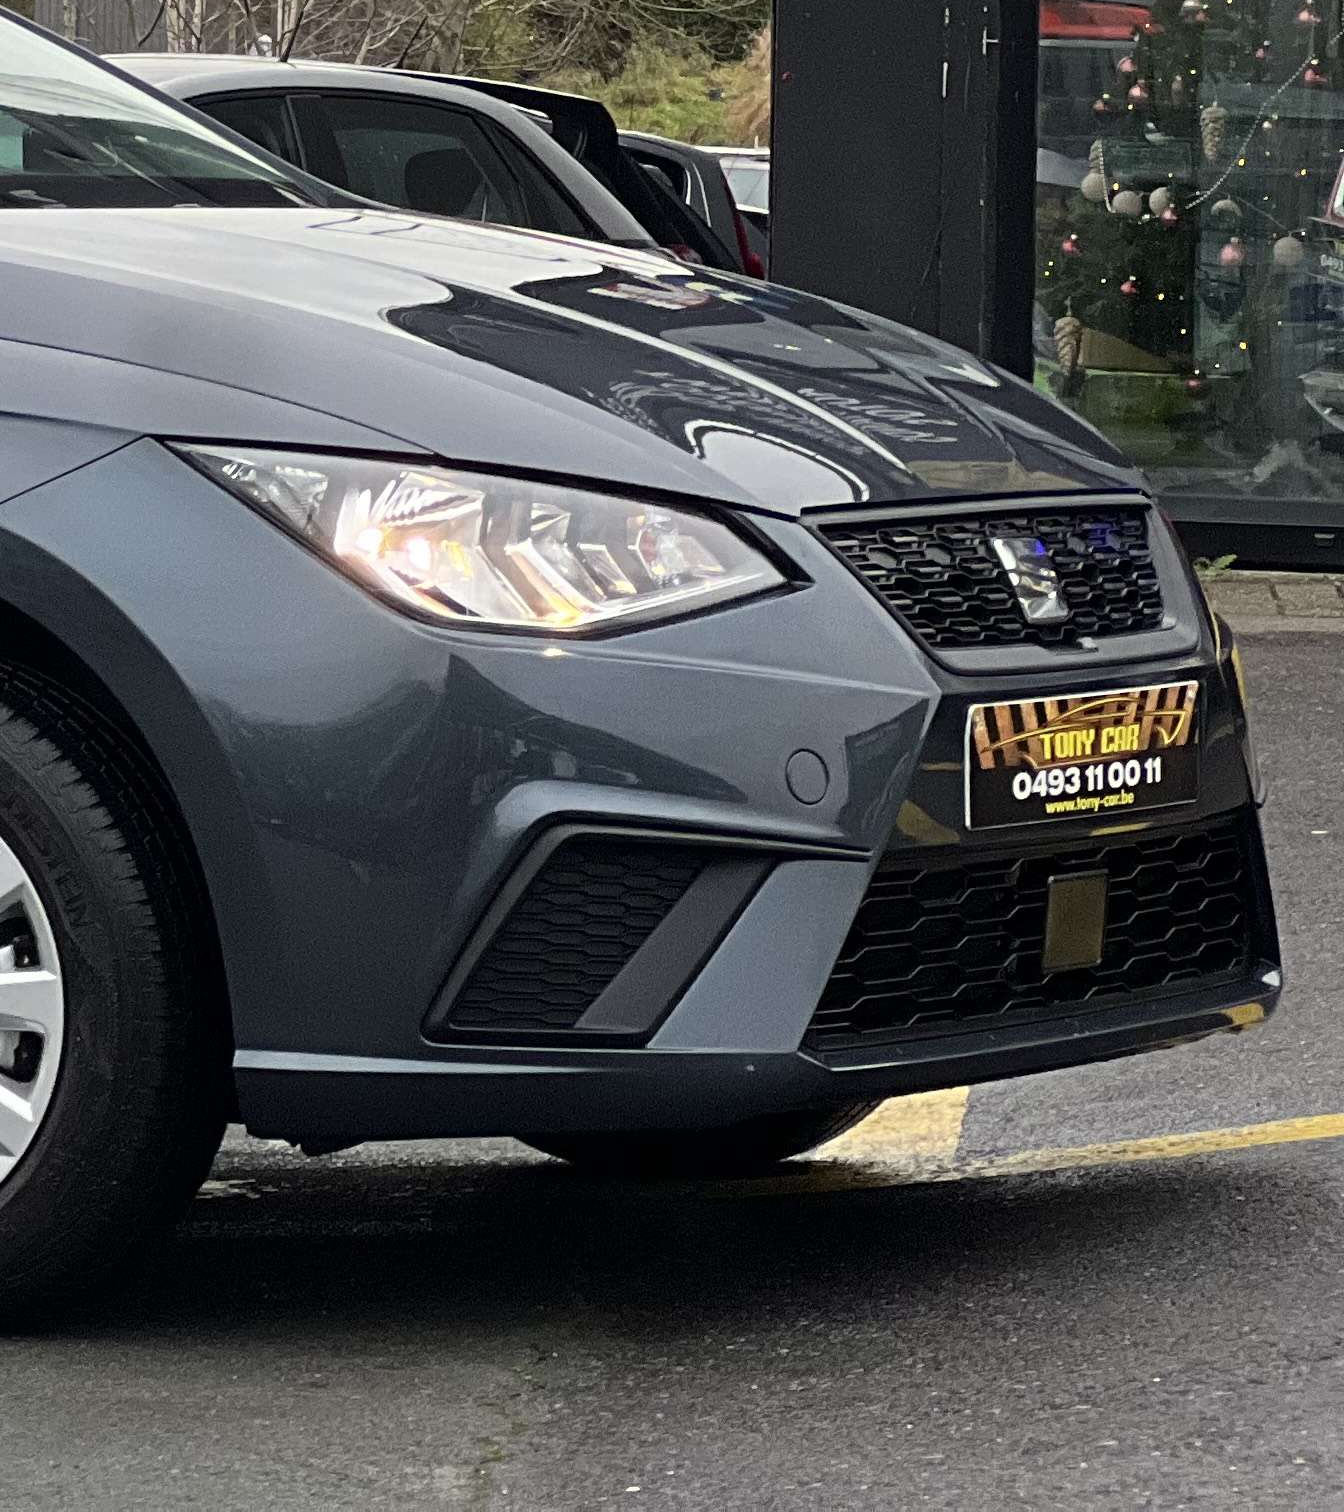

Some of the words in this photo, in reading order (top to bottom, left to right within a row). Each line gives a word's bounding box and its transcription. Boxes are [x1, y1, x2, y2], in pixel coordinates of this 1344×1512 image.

[1039, 730, 1096, 761] TONY
[1101, 724, 1140, 754] CAR
[1012, 766, 1081, 801] 0493
[1085, 763, 1104, 792] 11
[1107, 759, 1141, 788] 00
[1144, 756, 1162, 784] 11
[1045, 790, 1135, 814] www.tony-car.be
